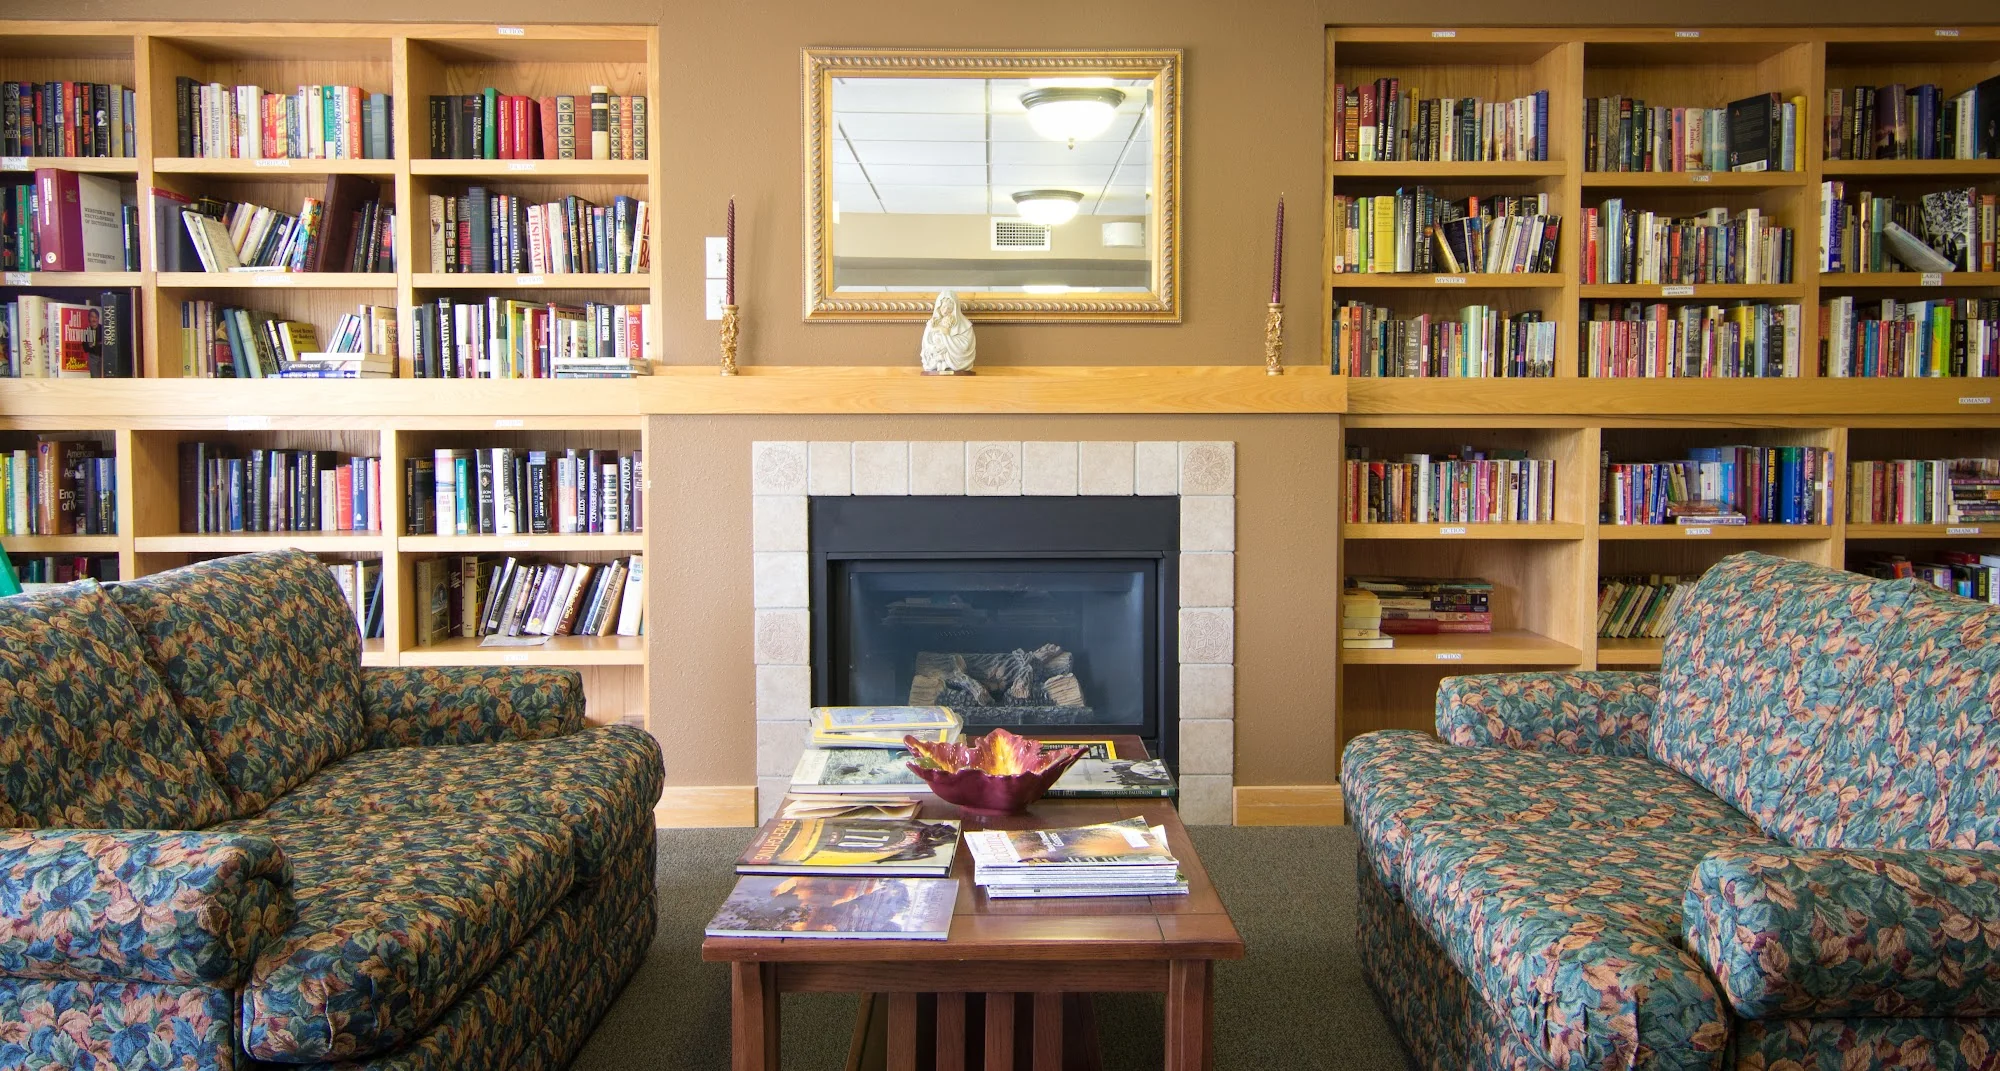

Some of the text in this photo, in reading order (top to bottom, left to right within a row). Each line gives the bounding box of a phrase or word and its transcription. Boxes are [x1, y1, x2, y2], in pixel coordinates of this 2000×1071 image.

[335, 100, 342, 109] MY
[1430, 104, 1438, 122] INDIA
[1689, 125, 1697, 150] Amber
[491, 197, 499, 215] HAROLD
[459, 222, 471, 248] GRAND
[459, 249, 471, 265] JURY
[69, 310, 81, 328] Jeff
[601, 307, 610, 341] HARLAN COBEN
[65, 324, 97, 342] Foxworthy
[440, 314, 450, 371] McNALLY'S SECRET
[22, 339, 35, 365] Heloise
[66, 360, 88, 369] Problem!
[67, 449, 95, 458] American
[623, 460, 631, 491] KOONTZ
[62, 501, 70, 511] of
[753, 819, 797, 861] FIREFIGHTING
